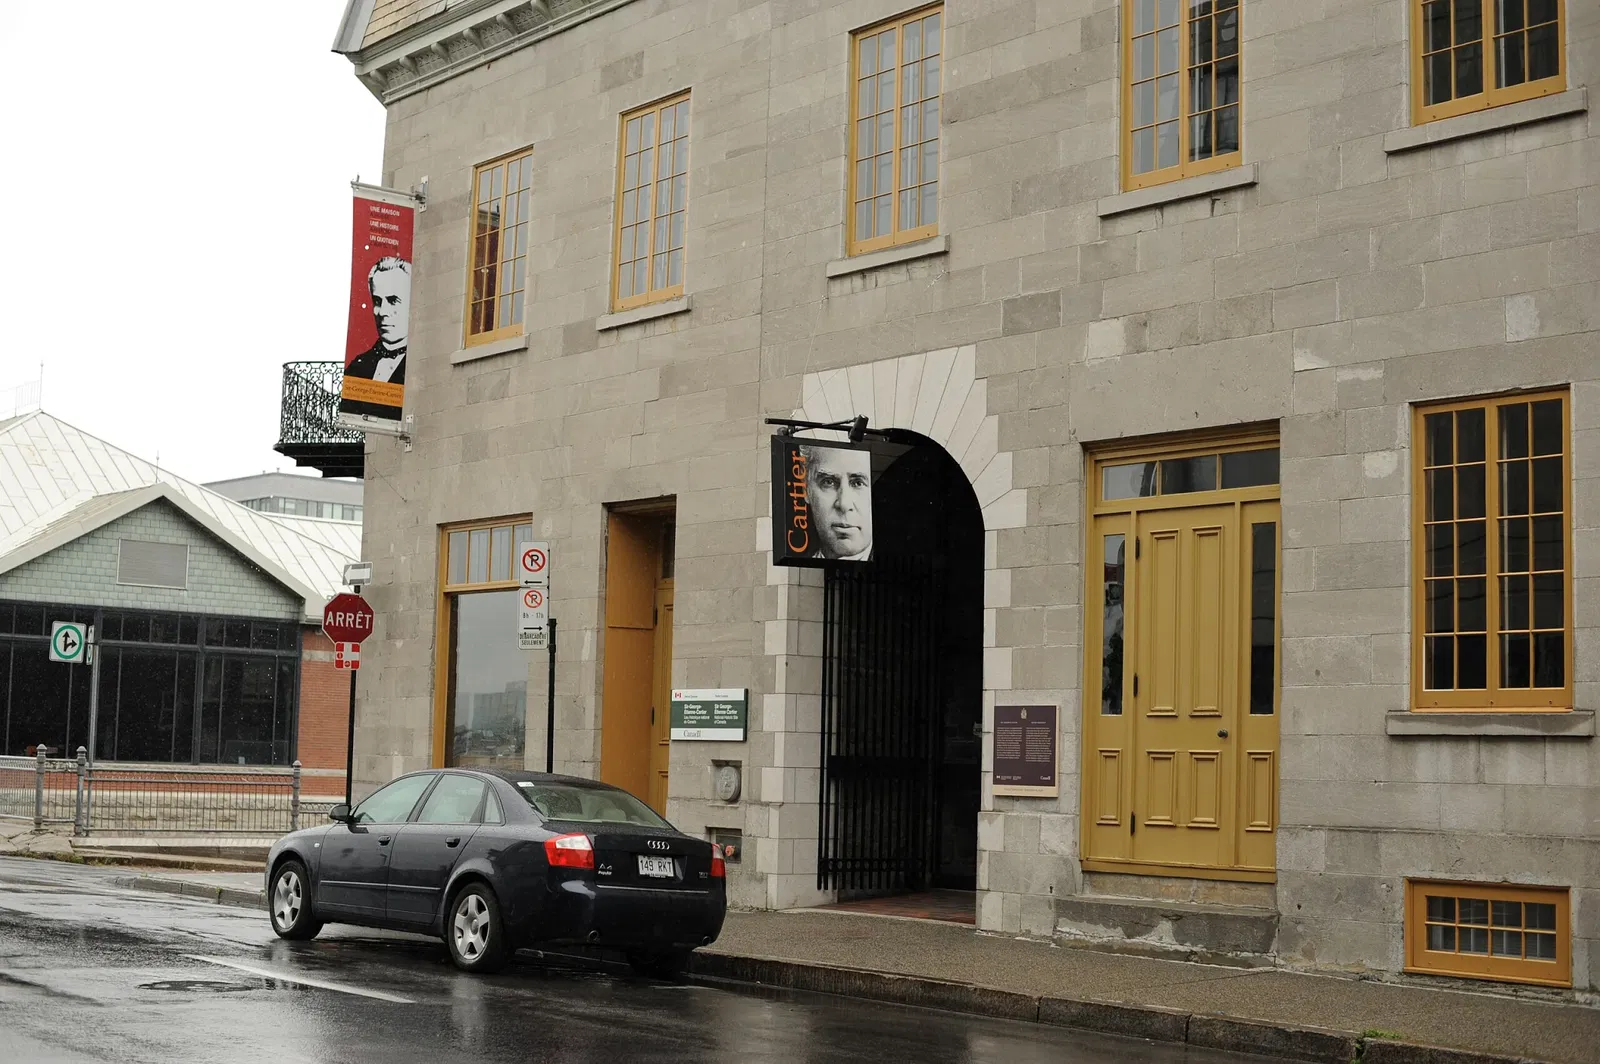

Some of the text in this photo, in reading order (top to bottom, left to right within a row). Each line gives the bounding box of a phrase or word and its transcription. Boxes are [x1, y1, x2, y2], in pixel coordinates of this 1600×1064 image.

[381, 207, 399, 216] MAISON
[380, 222, 399, 231] HISTOIRE
[377, 236, 398, 245] QUOTIDIEN
[786, 450, 809, 553] Cartier
[325, 611, 372, 630] ARRÊT
[640, 860, 672, 873] 149 RKT
